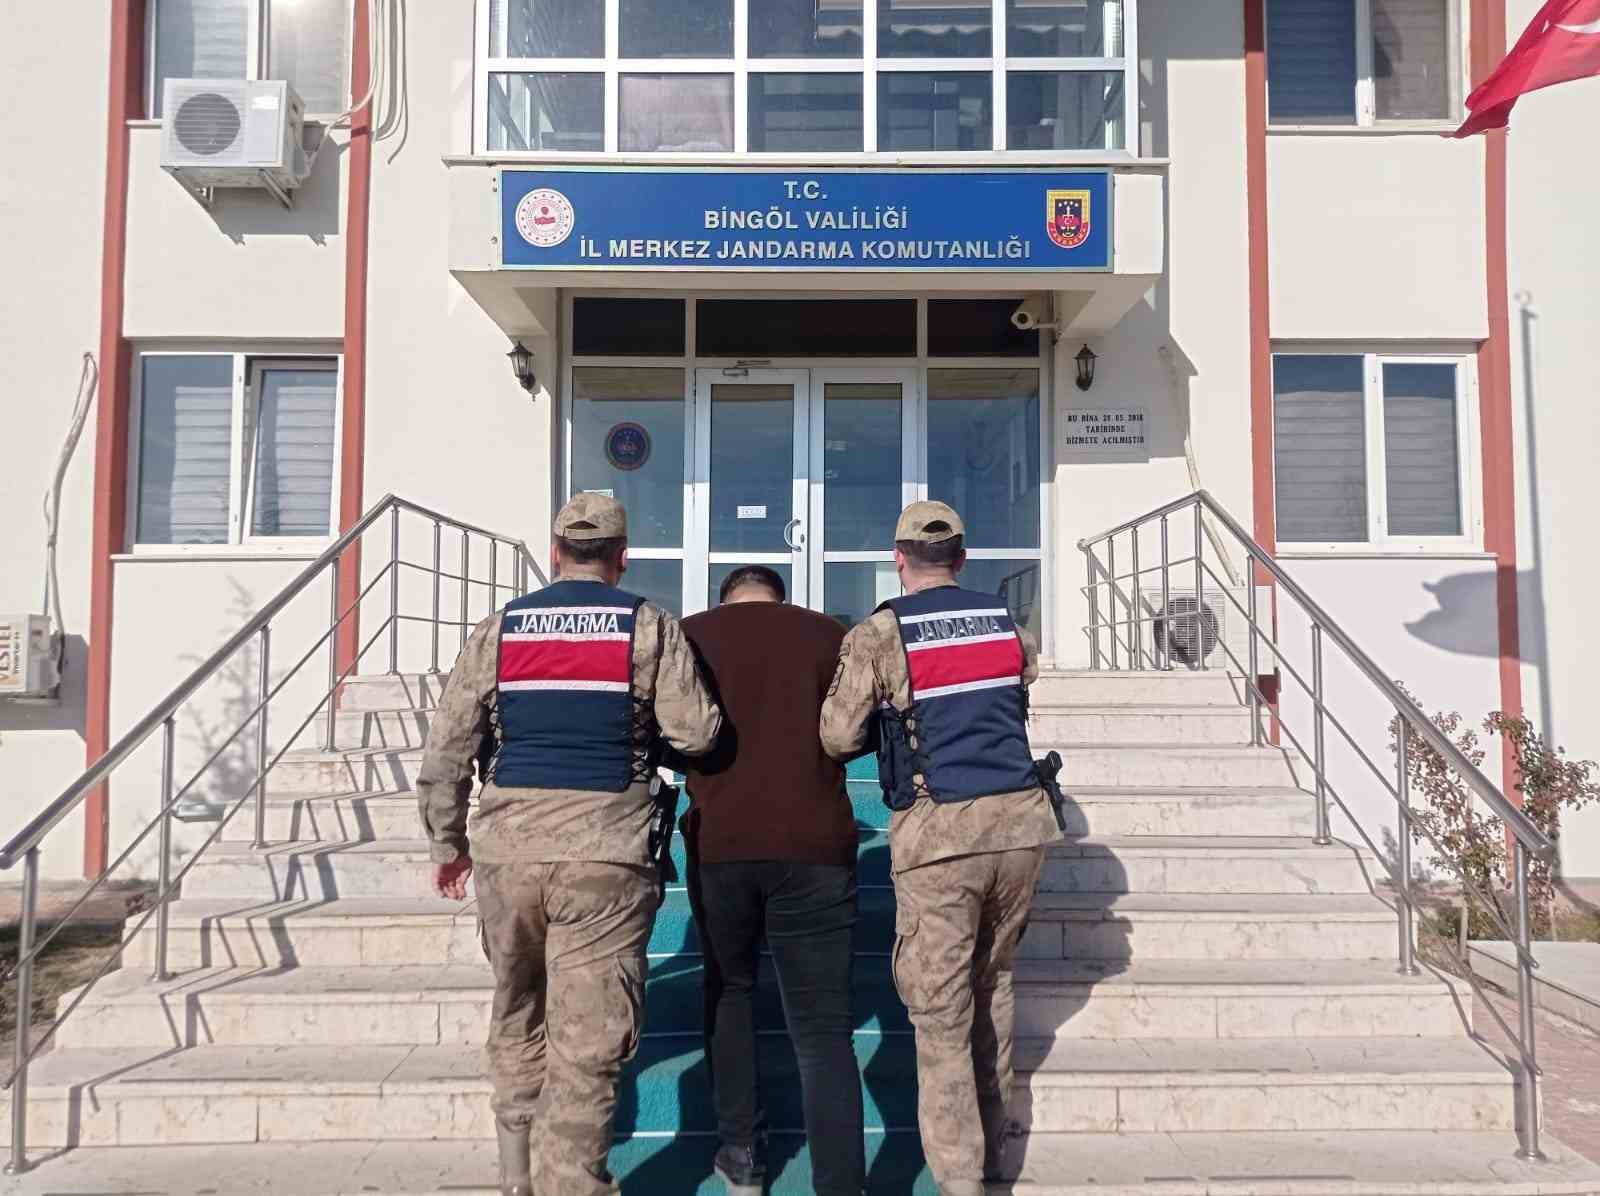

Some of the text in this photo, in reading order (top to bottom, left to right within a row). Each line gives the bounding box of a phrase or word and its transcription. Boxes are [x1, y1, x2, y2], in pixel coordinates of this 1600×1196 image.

[784, 181, 828, 199] T.C.
[704, 206, 908, 230] BİNGÖL VALİLİĞİ
[580, 235, 601, 257] İL
[609, 239, 711, 259] MERKEZ
[717, 240, 855, 260] JANDARMA
[862, 235, 1031, 260] KOMUTANLIĞI
[514, 613, 619, 633] JANDARMA
[916, 616, 1001, 642] JANDARMA
